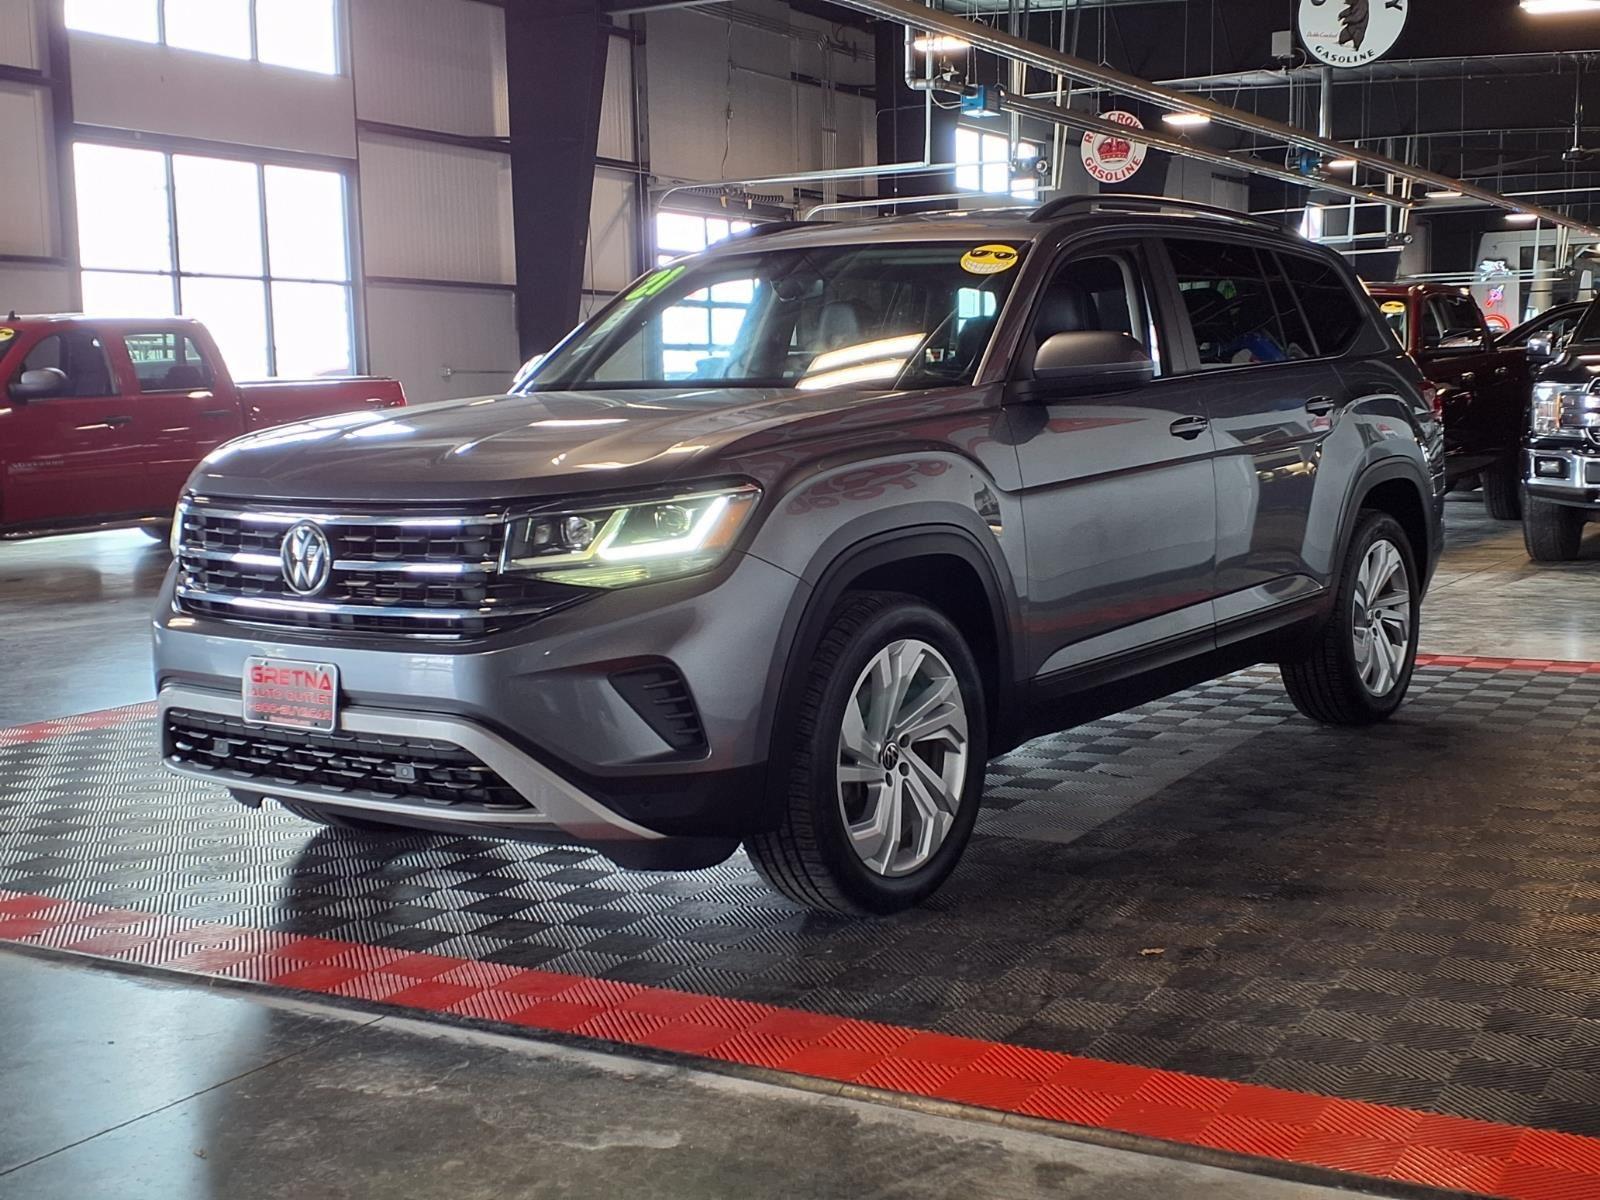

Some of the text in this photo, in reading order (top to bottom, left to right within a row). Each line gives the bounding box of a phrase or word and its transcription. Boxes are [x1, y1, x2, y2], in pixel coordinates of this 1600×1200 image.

[1315, 45, 1375, 63] GASOLINE
[1085, 156, 1141, 181] GASOLINE
[251, 665, 332, 691] GRETNA
